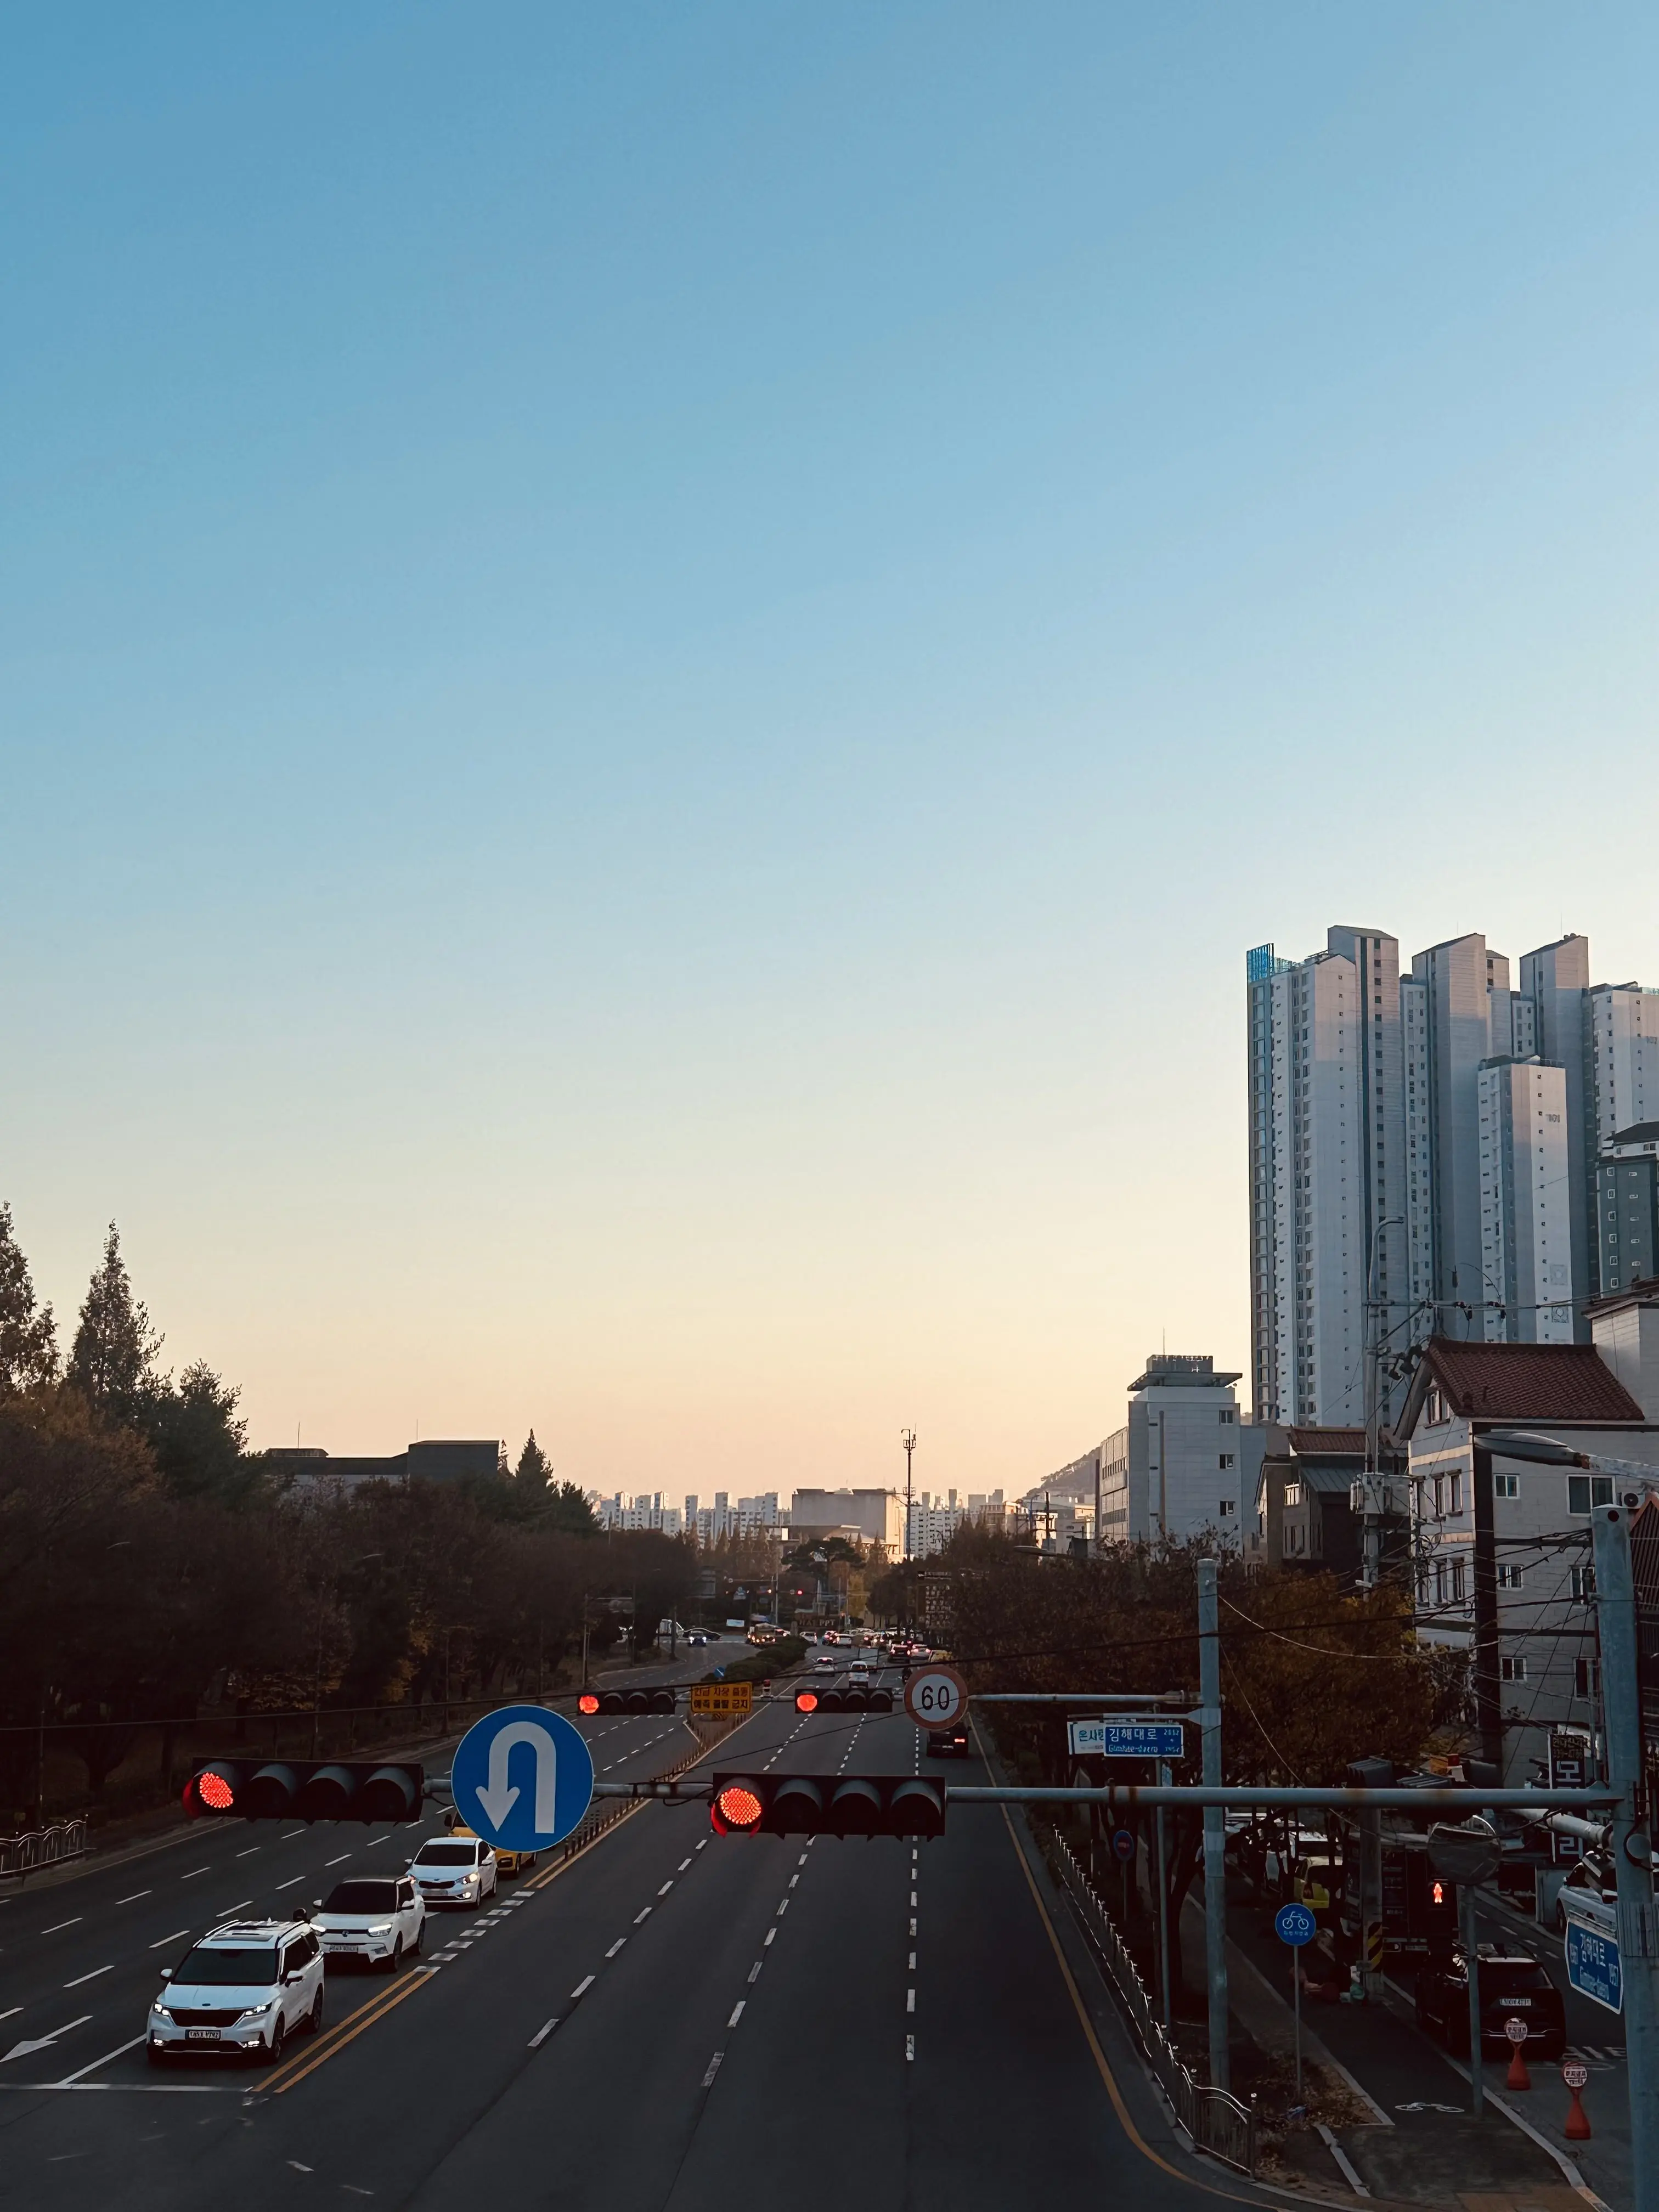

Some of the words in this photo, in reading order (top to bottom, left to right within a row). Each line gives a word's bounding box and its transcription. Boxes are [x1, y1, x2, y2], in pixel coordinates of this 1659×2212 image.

[922, 1685, 950, 1710] 60
[1109, 1728, 1157, 1742] 김해대로
[1579, 1933, 1606, 1967] 김해대로
